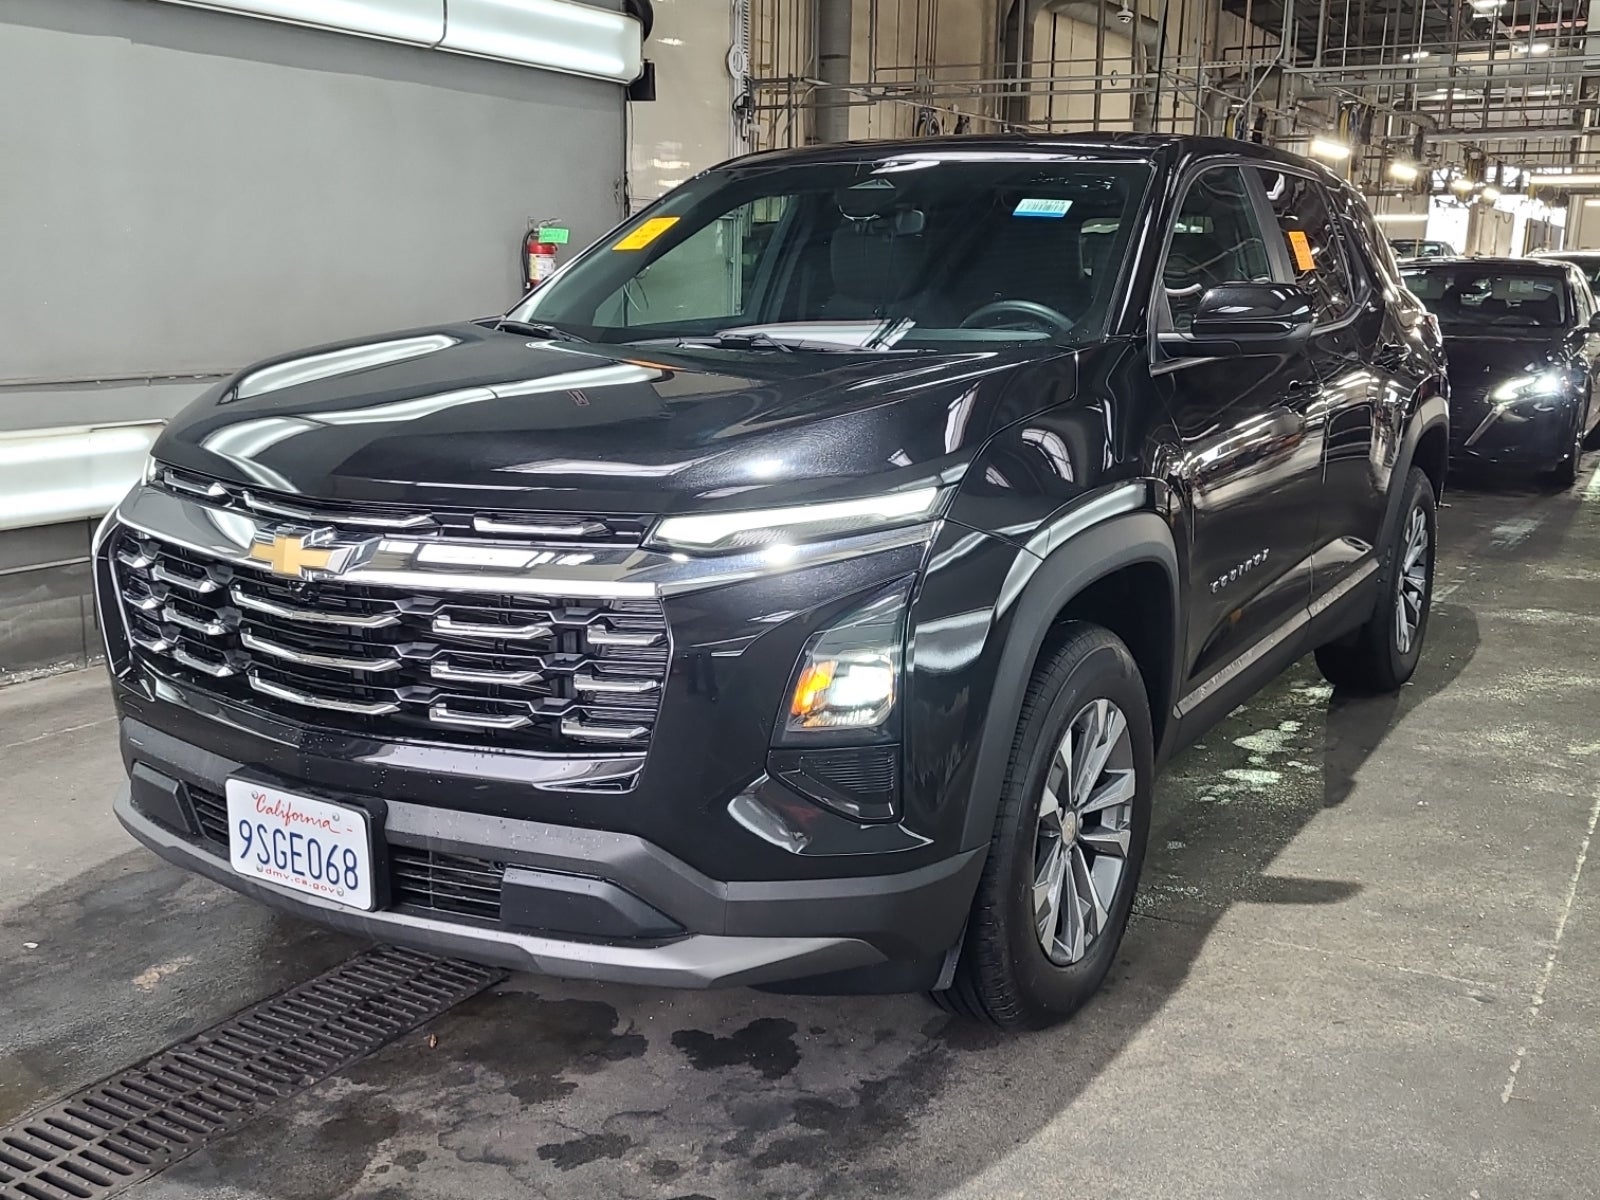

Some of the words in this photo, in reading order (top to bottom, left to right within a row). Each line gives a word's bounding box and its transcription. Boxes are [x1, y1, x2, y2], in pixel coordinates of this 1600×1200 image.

[256, 794, 341, 834] California
[238, 819, 359, 891] 9SGE068
[265, 867, 336, 894] dmv.ca.gov
